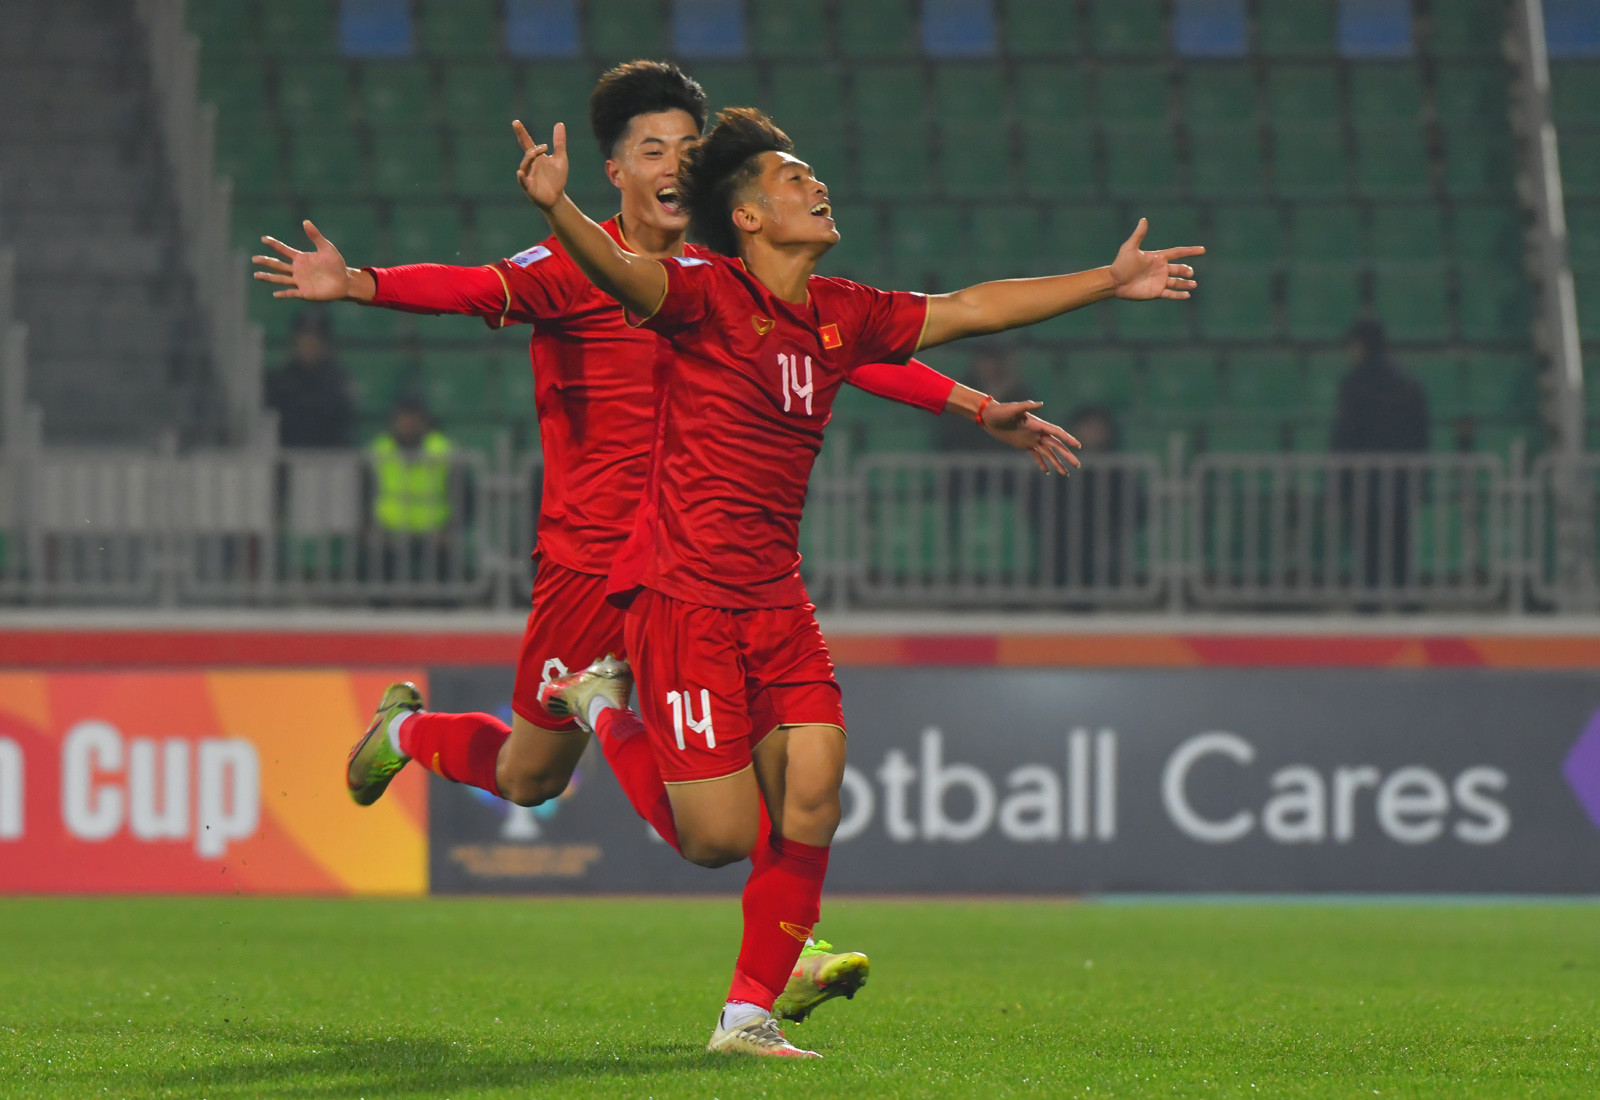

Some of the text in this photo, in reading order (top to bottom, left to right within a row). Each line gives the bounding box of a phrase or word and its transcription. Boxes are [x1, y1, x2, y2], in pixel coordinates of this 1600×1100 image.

[777, 352, 813, 416] 14
[666, 688, 716, 750] 14
[61, 719, 260, 858] Cup
[1161, 731, 1511, 843] Cares
